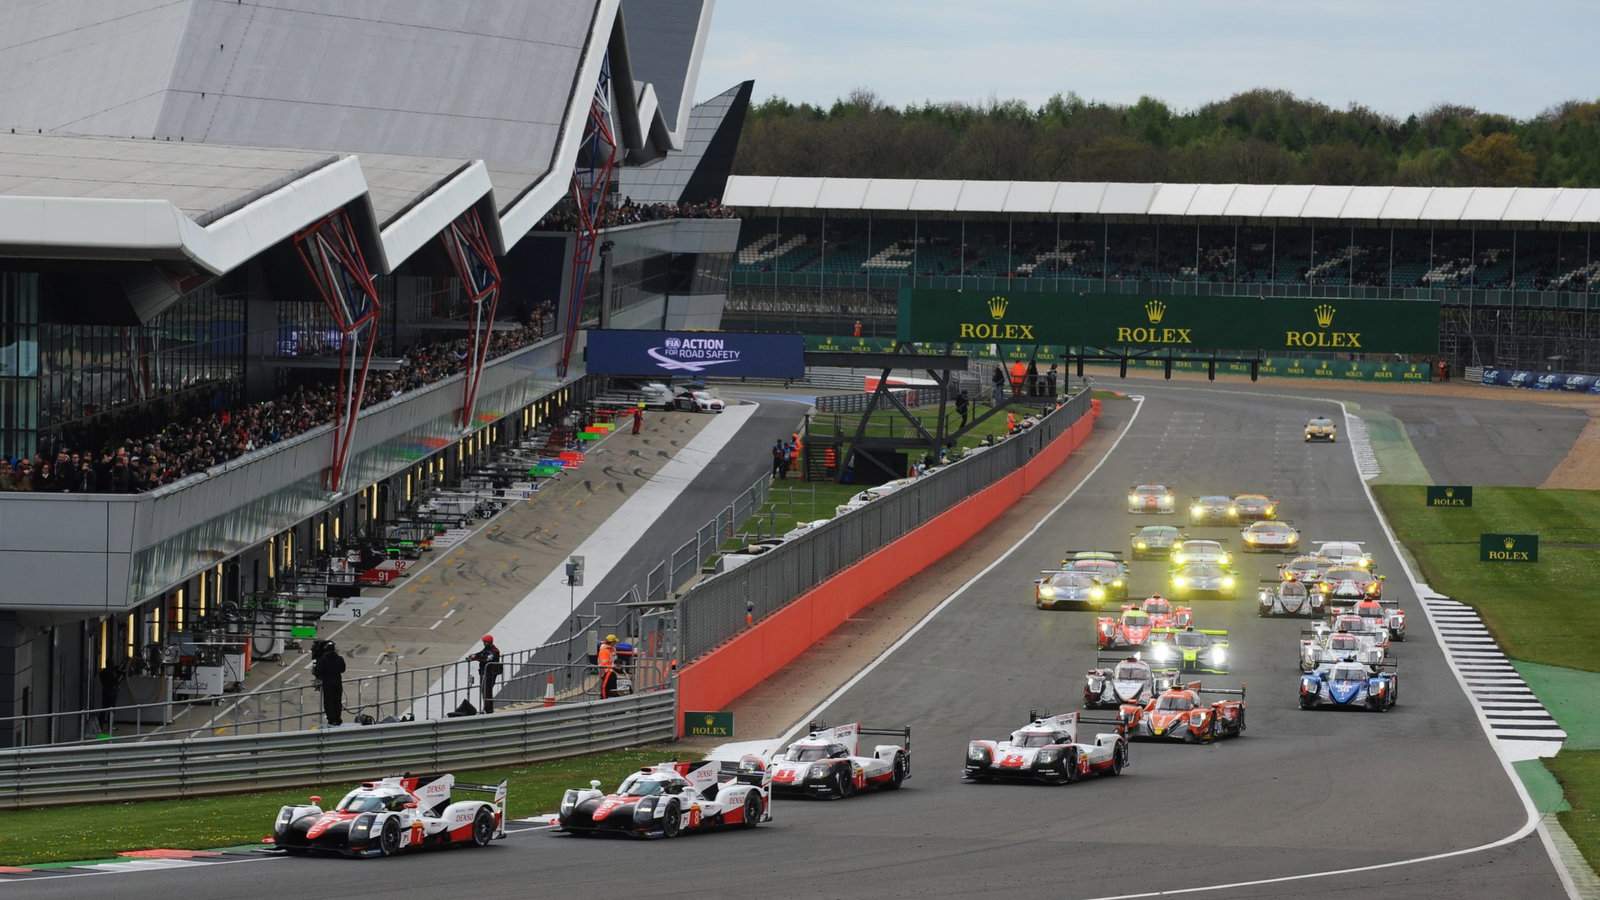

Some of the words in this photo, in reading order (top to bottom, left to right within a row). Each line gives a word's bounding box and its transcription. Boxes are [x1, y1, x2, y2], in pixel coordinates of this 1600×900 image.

[960, 324, 1035, 340] ROLEX
[1117, 328, 1192, 344] ROLEX
[1285, 331, 1362, 348] ROLEX
[682, 340, 724, 350] ACTION
[680, 350, 704, 359] ROAD
[706, 351, 740, 359] SAFETY
[1489, 551, 1529, 560] ROLEX
[395, 561, 406, 570] 92
[378, 571, 389, 581] 91
[352, 608, 361, 618] 13
[692, 727, 727, 735] ROLEX
[697, 769, 713, 778] DENSO
[427, 785, 446, 793] DENSO
[729, 797, 745, 805] DENSO
[456, 813, 475, 822] DENSO
[694, 811, 699, 824] 8
